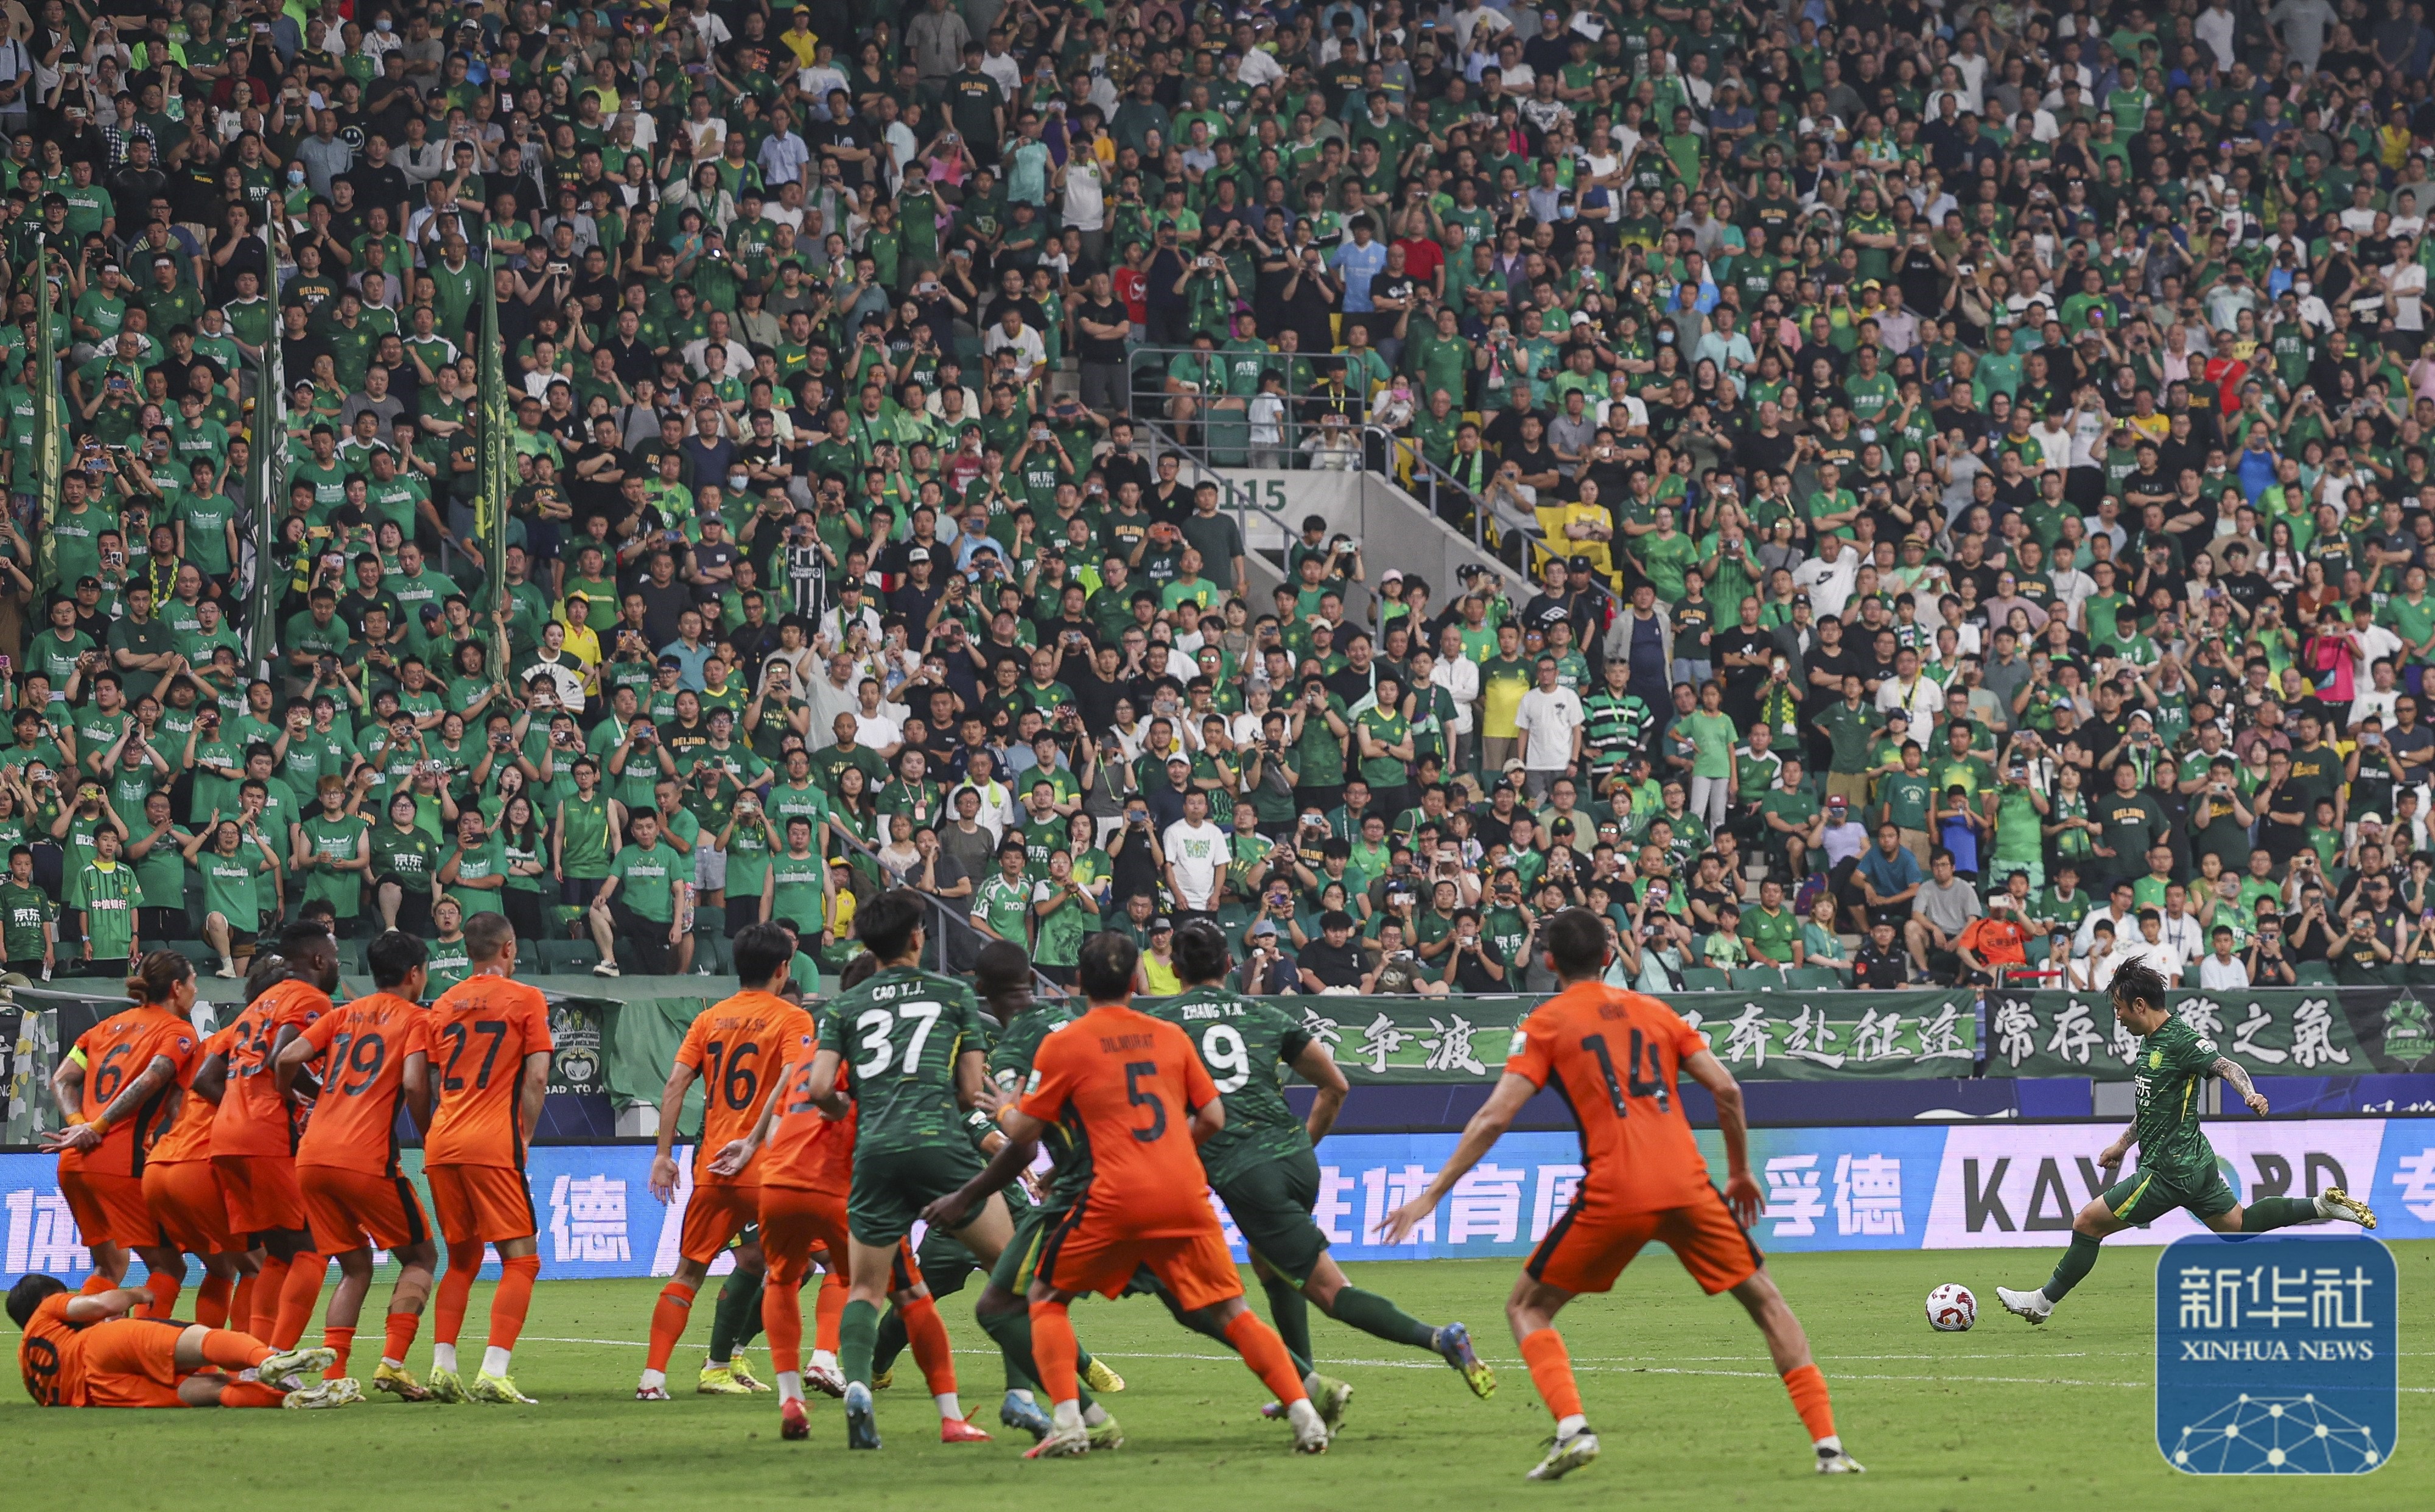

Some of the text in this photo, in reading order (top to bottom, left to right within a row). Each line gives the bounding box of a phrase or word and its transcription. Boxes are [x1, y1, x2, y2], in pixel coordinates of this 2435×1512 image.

[1219, 479, 1286, 513] 115
[672, 737, 706, 747] BEIJING
[393, 853, 423, 868] 京东
[13, 908, 41, 923] 京东
[92, 899, 127, 911] 中信银行
[872, 982, 925, 1001] CAO Y.J.
[1182, 1003, 1220, 1020] ZHANG
[94, 1043, 131, 1104] 6
[330, 1027, 390, 1098] 19
[445, 1021, 507, 1090] 27
[855, 1001, 943, 1080] 37
[1202, 1024, 1250, 1094] 9
[1582, 1029, 1670, 1119] 14
[706, 1040, 759, 1111] 16
[1126, 1061, 1166, 1143] 5
[550, 1172, 631, 1263] 德
[1764, 1152, 1907, 1238] 孚德
